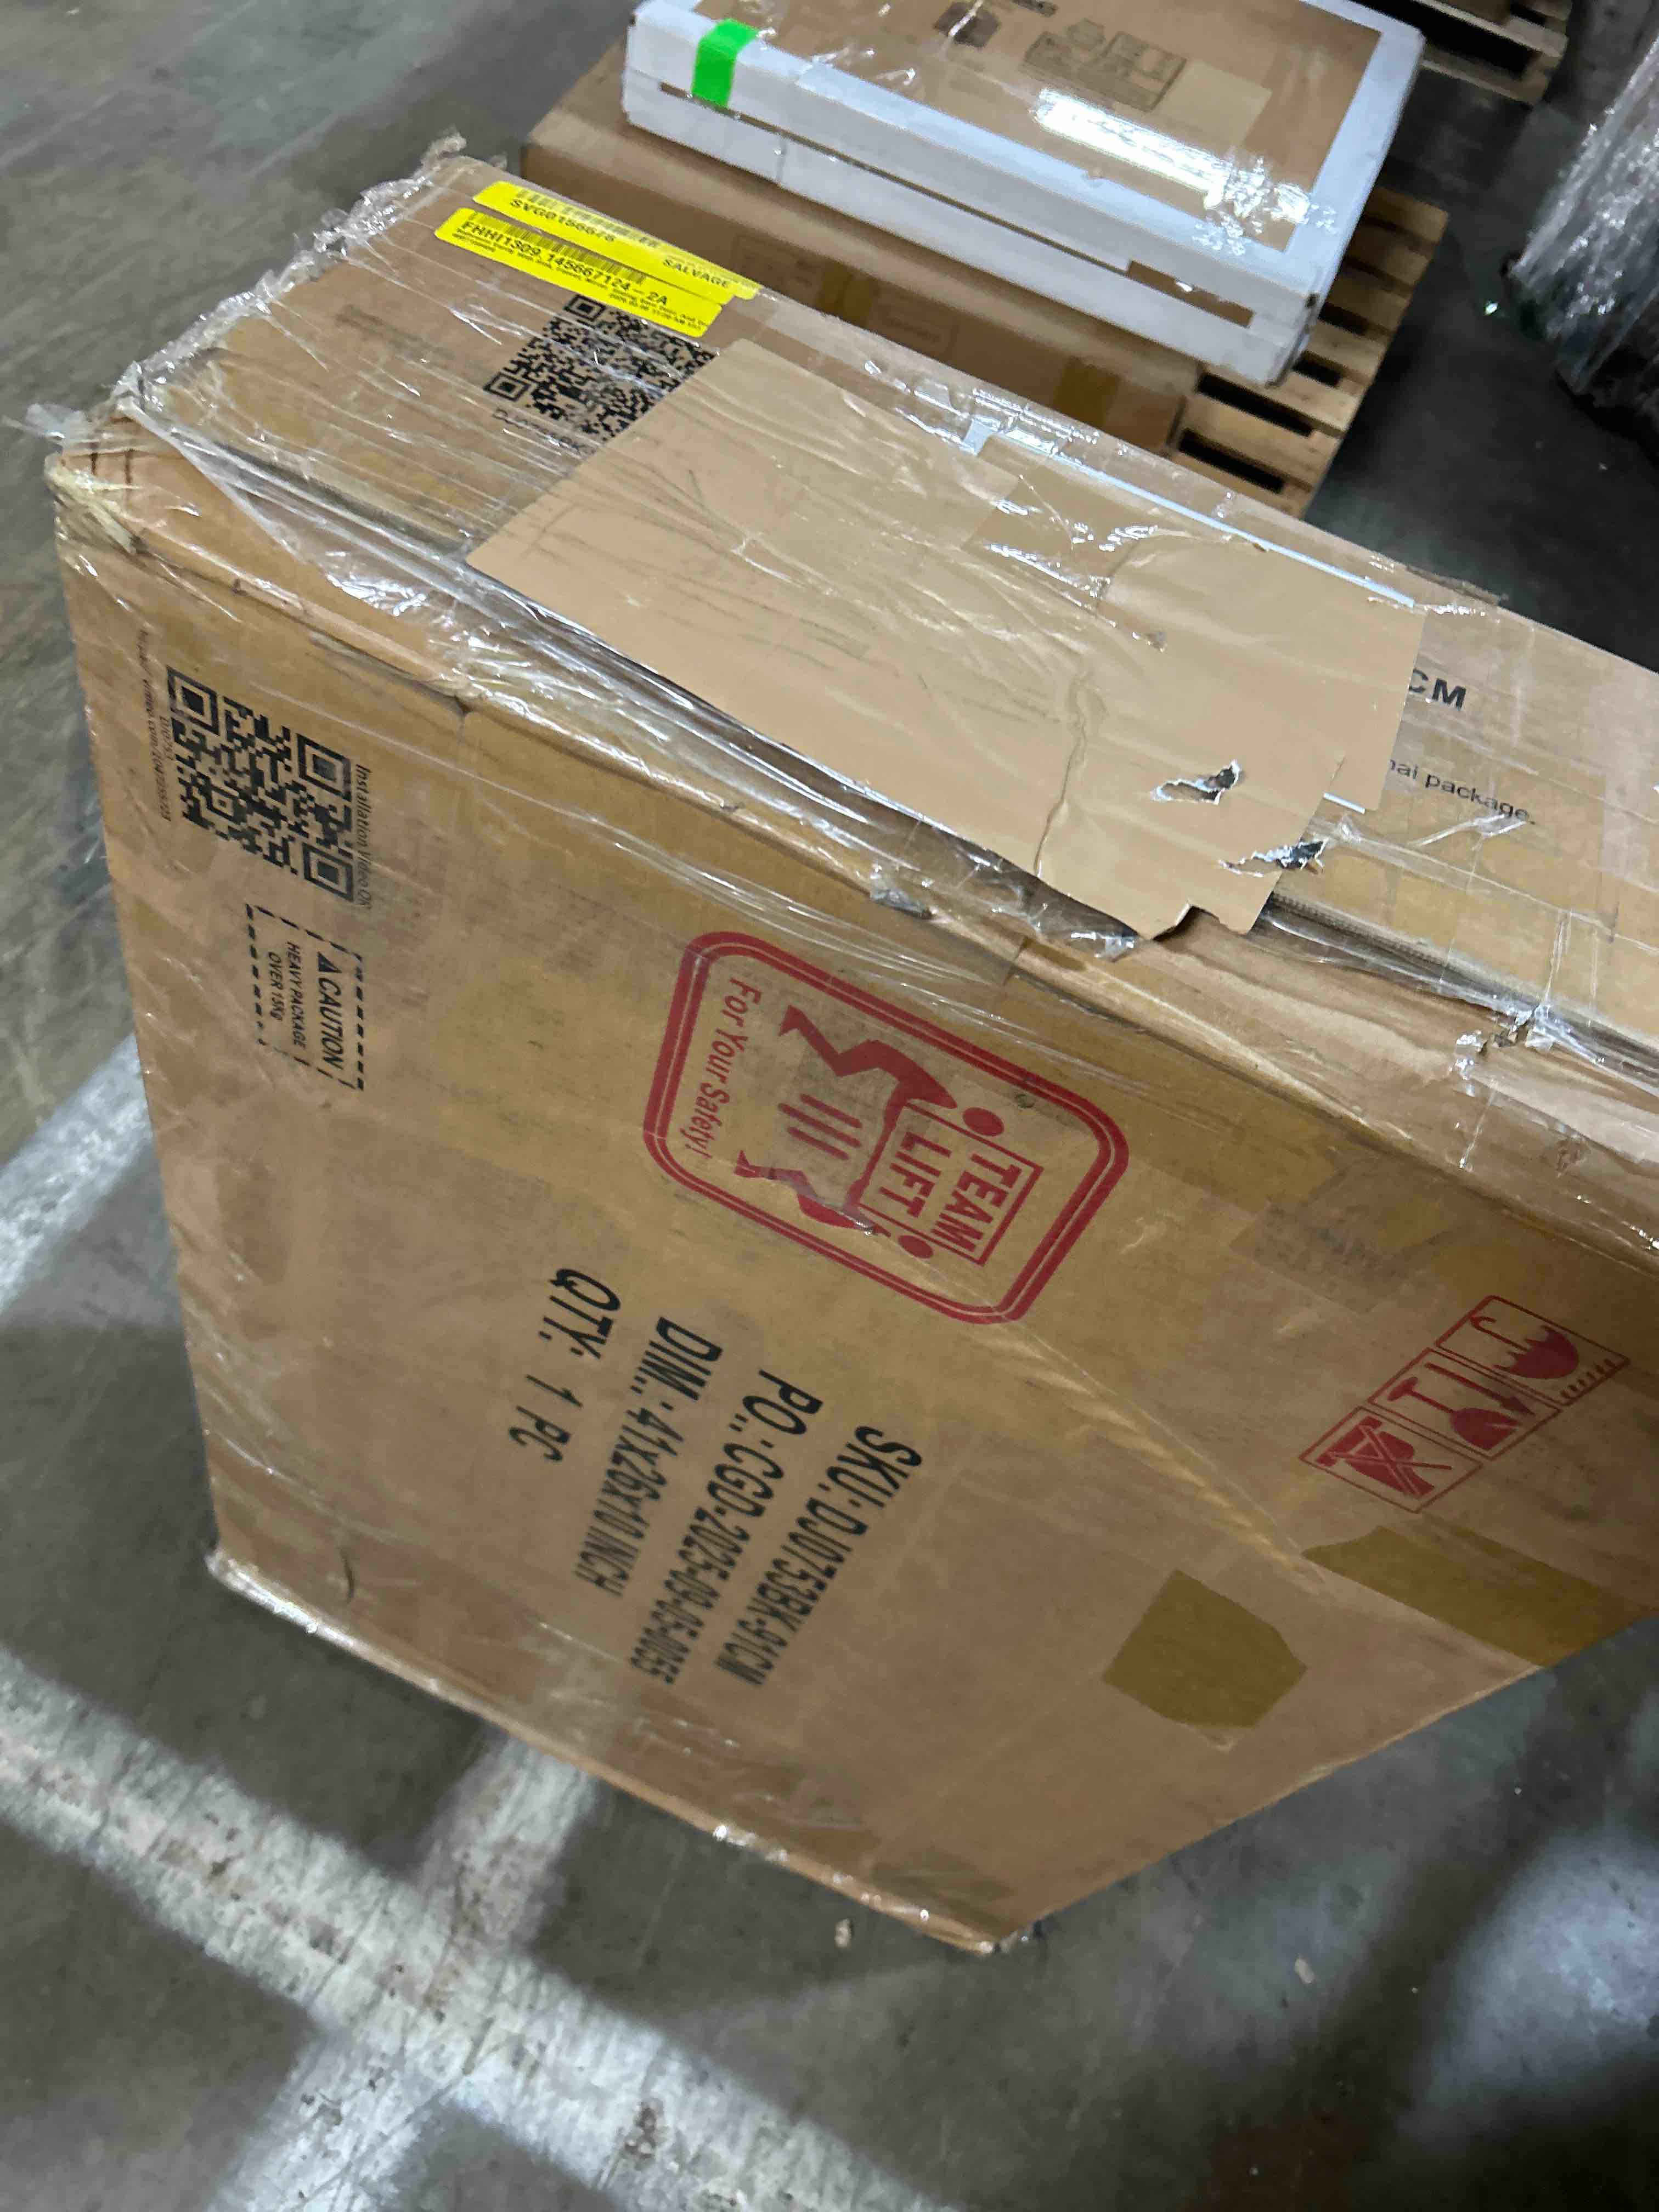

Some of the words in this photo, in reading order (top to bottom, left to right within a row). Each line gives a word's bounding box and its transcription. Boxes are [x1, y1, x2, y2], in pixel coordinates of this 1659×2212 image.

[663, 258, 731, 288] SALVAGE
[356, 764, 372, 847] Installation
[358, 851, 371, 886] Video
[267, 952, 284, 990] OVER
[287, 941, 302, 985] HEAVY
[288, 986, 308, 1049] PACKAGE
[318, 978, 345, 1069] CAUTION
[729, 979, 761, 1026] For
[708, 1029, 750, 1095] Your
[679, 1082, 731, 1160] Safety!
[877, 1133, 951, 1218] LIFT
[930, 1154, 1022, 1253] TEAM
[539, 1268, 621, 1359] QTY:
[526, 1373, 583, 1408] 1
[508, 1405, 571, 1462] PC
[819, 1426, 923, 1509] SKU:
[594, 1407, 684, 1542] 41x26x10
[574, 1526, 640, 1597] INCH
